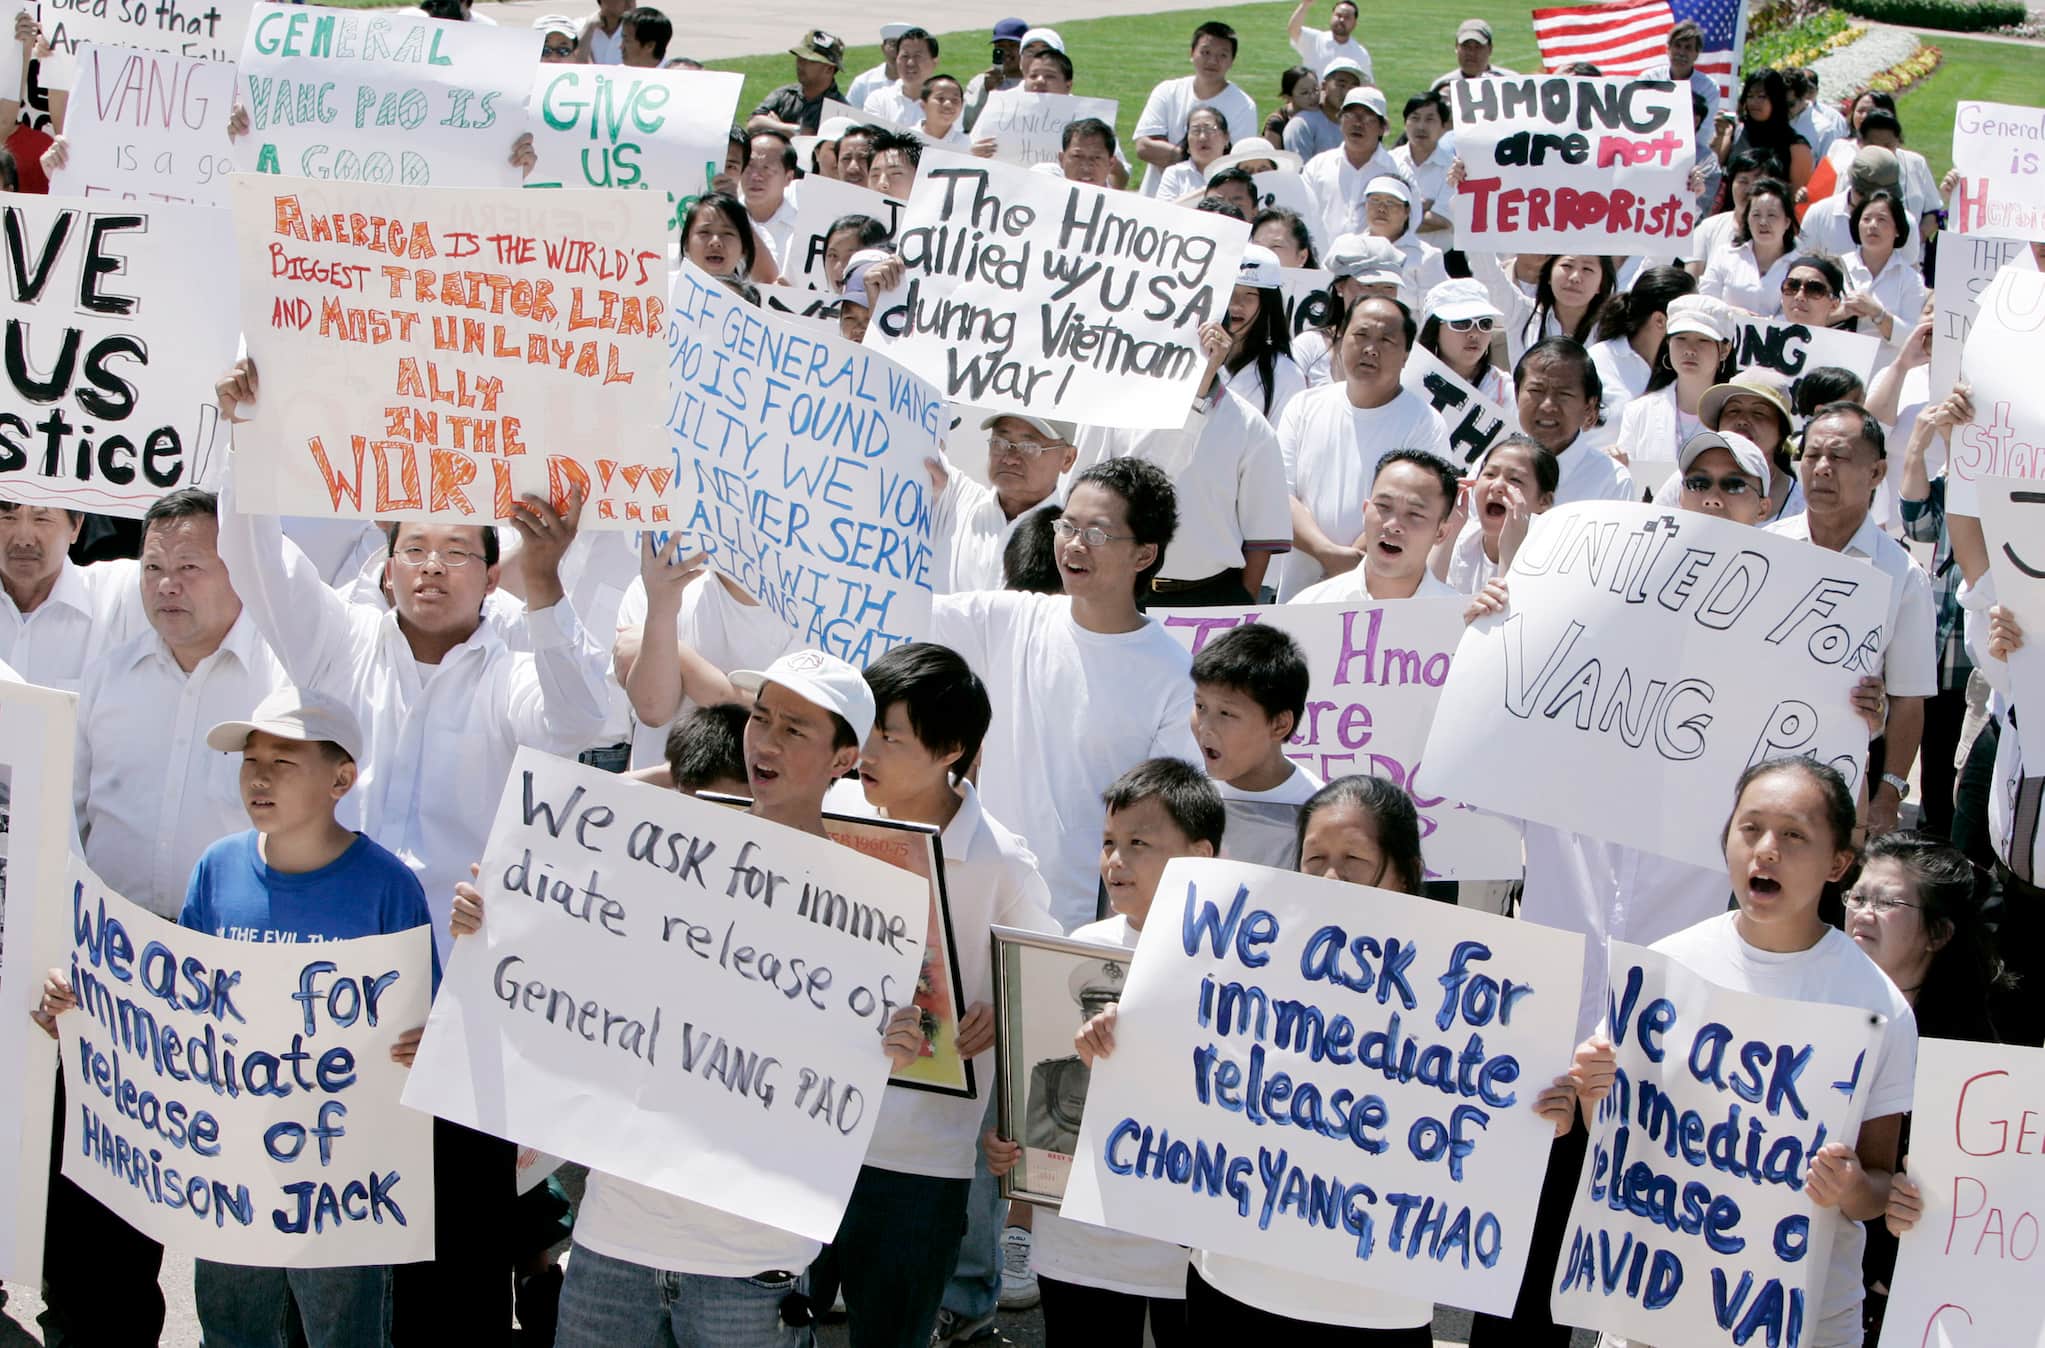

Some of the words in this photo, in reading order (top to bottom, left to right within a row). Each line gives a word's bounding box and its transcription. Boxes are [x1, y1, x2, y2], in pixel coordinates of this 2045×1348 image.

[155, 3, 222, 38] that
[255, 12, 453, 66] GENERAL
[93, 49, 209, 130] VANG
[249, 75, 338, 130] VANG
[355, 86, 428, 130] PAO
[440, 88, 502, 129] IS
[1457, 79, 1676, 133] HMONG
[154, 152, 173, 174] a
[256, 144, 281, 174] A
[301, 144, 430, 186] GOOD
[1495, 131, 1590, 166] are
[1597, 130, 1683, 168] not
[2010, 148, 2040, 174] is
[269, 242, 371, 293] BIGGEST
[443, 232, 480, 259] IS
[486, 233, 536, 265] THE
[542, 239, 661, 286] WORLD'S
[899, 226, 1030, 292] allied
[928, 168, 1036, 237] The
[1057, 185, 1216, 289] Hmong
[272, 296, 312, 332] AND
[319, 295, 421, 345] MOST
[676, 273, 722, 328] IF
[722, 306, 877, 402] GENERAL
[888, 366, 940, 445] VANG
[879, 279, 1016, 354] during
[1041, 303, 1197, 380] Vietnam
[1736, 323, 1812, 376] NG
[397, 356, 503, 412] ALLY
[700, 350, 751, 411] IS
[760, 376, 890, 458] FOUND
[384, 406, 438, 446] IN
[445, 415, 526, 457] THE
[694, 458, 816, 557] NEVER
[818, 517, 933, 592] SERVE
[784, 443, 869, 511] WE
[880, 466, 934, 540] VOW
[687, 499, 769, 571] ALLY
[775, 551, 897, 629] WITH
[1765, 577, 1883, 674] FOR
[1290, 701, 1373, 749] re
[1502, 612, 1715, 762] VANG
[522, 770, 615, 853] We
[726, 840, 790, 910] for
[74, 879, 135, 982] We
[291, 960, 401, 1037] for
[503, 849, 627, 937] diate
[662, 914, 833, 1010] release
[848, 973, 901, 1037] of
[1182, 879, 1280, 969] We
[1436, 940, 1535, 1032] for
[71, 951, 358, 1099] immediate
[493, 954, 662, 1066] General
[681, 1022, 783, 1109] VANG
[794, 1065, 864, 1136] PAO
[1198, 971, 1520, 1109] immediate
[79, 1035, 221, 1157] release
[263, 1100, 348, 1167] of
[1193, 1042, 1390, 1156] release
[1408, 1104, 1491, 1184] of
[1956, 1071, 2045, 1156] GE
[272, 1169, 407, 1234] JACK
[1386, 1192, 1503, 1270] THAO
[1945, 1176, 2039, 1261] PAO
[1560, 1224, 1683, 1311] DAVID
